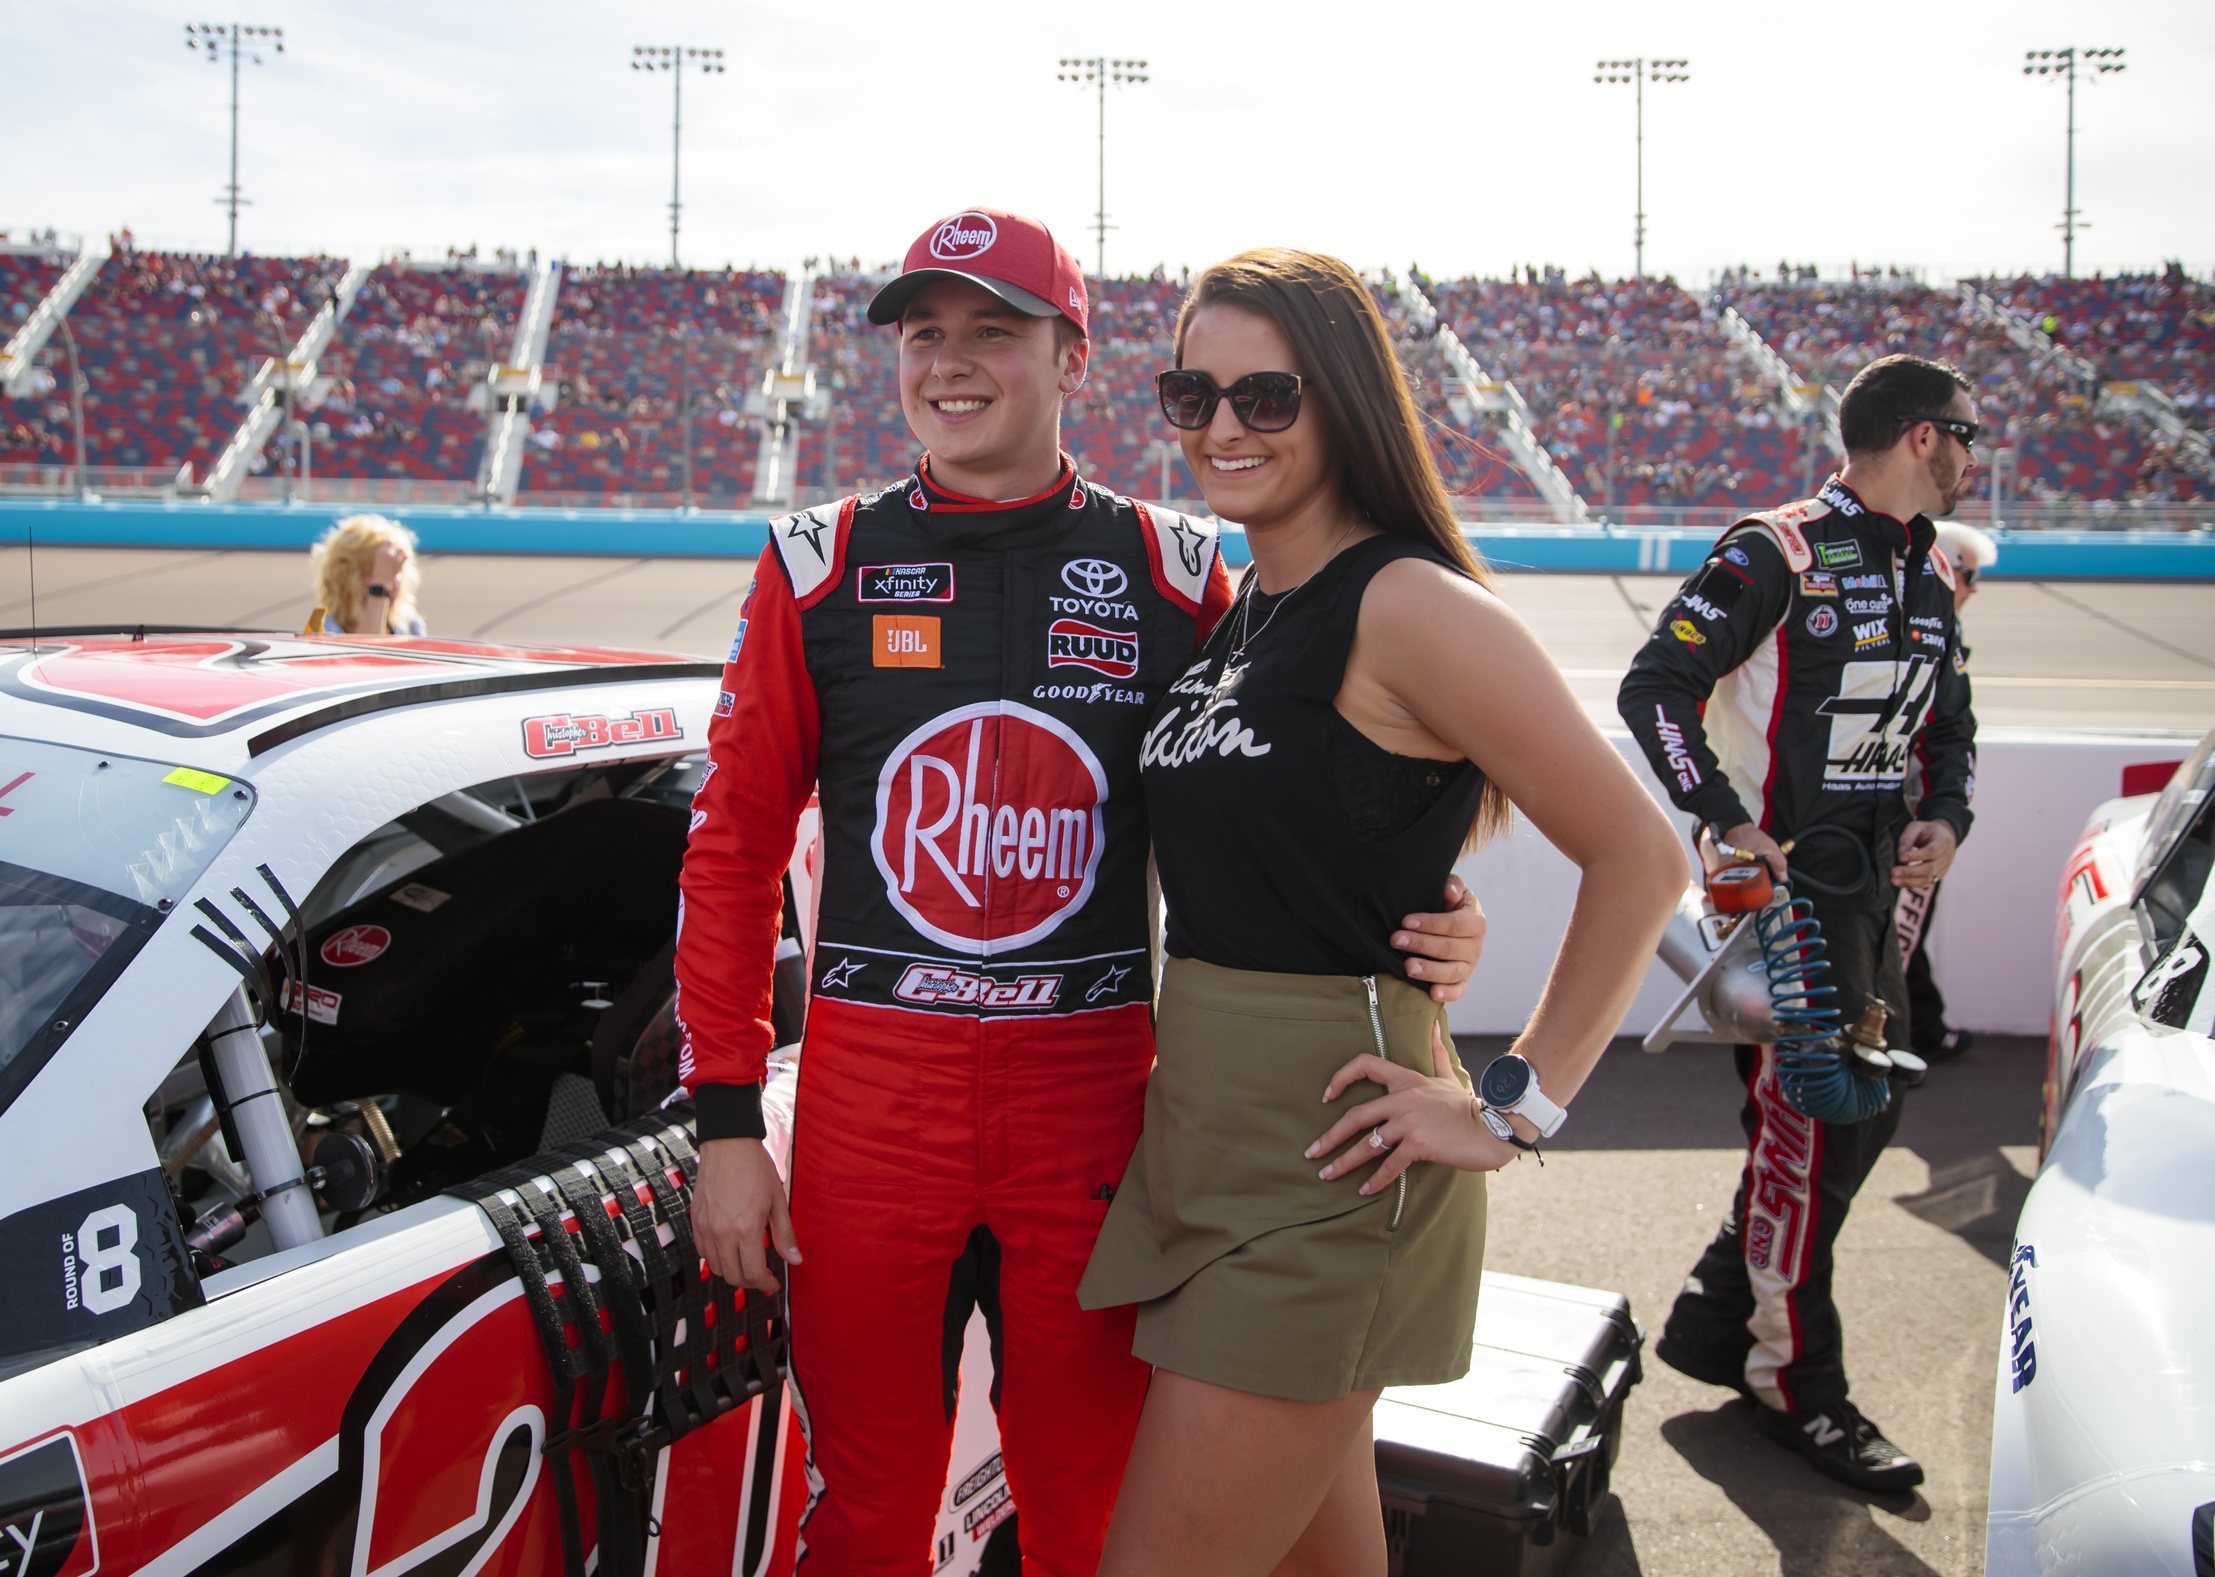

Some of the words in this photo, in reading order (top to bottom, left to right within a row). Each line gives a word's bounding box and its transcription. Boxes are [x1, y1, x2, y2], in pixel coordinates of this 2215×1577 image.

[937, 217, 992, 255] Rheem
[895, 567, 926, 576] NASCAR
[874, 576, 938, 594] xfinity
[894, 590, 920, 598] SERIES
[1049, 596, 1139, 621] TOYOTA
[887, 629, 927, 653] JBL
[1853, 617, 1889, 641] WIX
[1051, 634, 1136, 663] RUUD
[1033, 683, 1145, 705] GOODYEAR
[1677, 771, 1693, 792] CNC
[900, 717, 1087, 907] Rheem
[2136, 946, 2202, 1002] 8
[62, 1232, 75, 1252] OF
[1749, 1215, 1775, 1270] CNC
[77, 1202, 142, 1316] 8
[63, 1258, 79, 1311] ROUND
[1802, 1413, 1846, 1448] N
